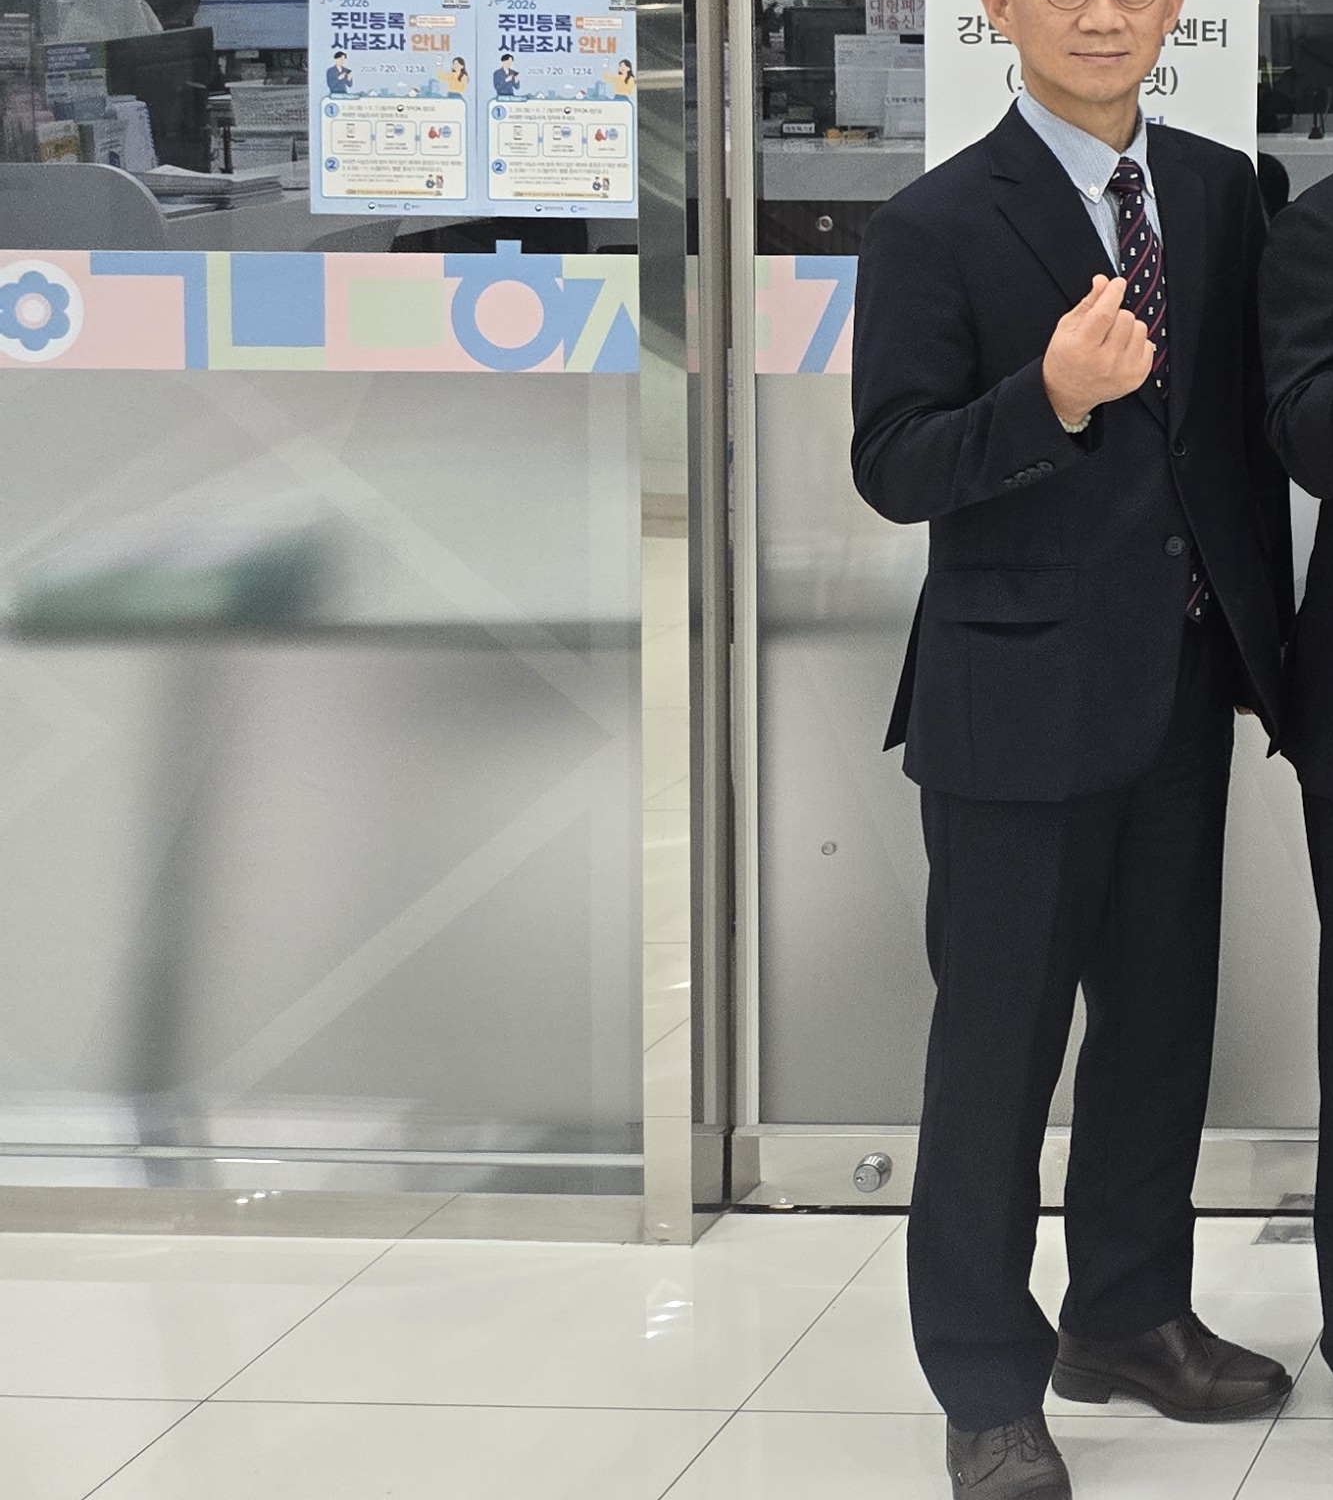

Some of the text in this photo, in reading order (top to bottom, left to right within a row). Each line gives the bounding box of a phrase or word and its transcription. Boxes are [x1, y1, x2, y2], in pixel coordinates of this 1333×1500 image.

[507, 0, 537, 10] 2026
[331, 11, 406, 30] 주민등록
[498, 13, 573, 32] 주민등록
[331, 32, 450, 52] 사실조사 안내
[498, 34, 617, 54] 사실조사 안내
